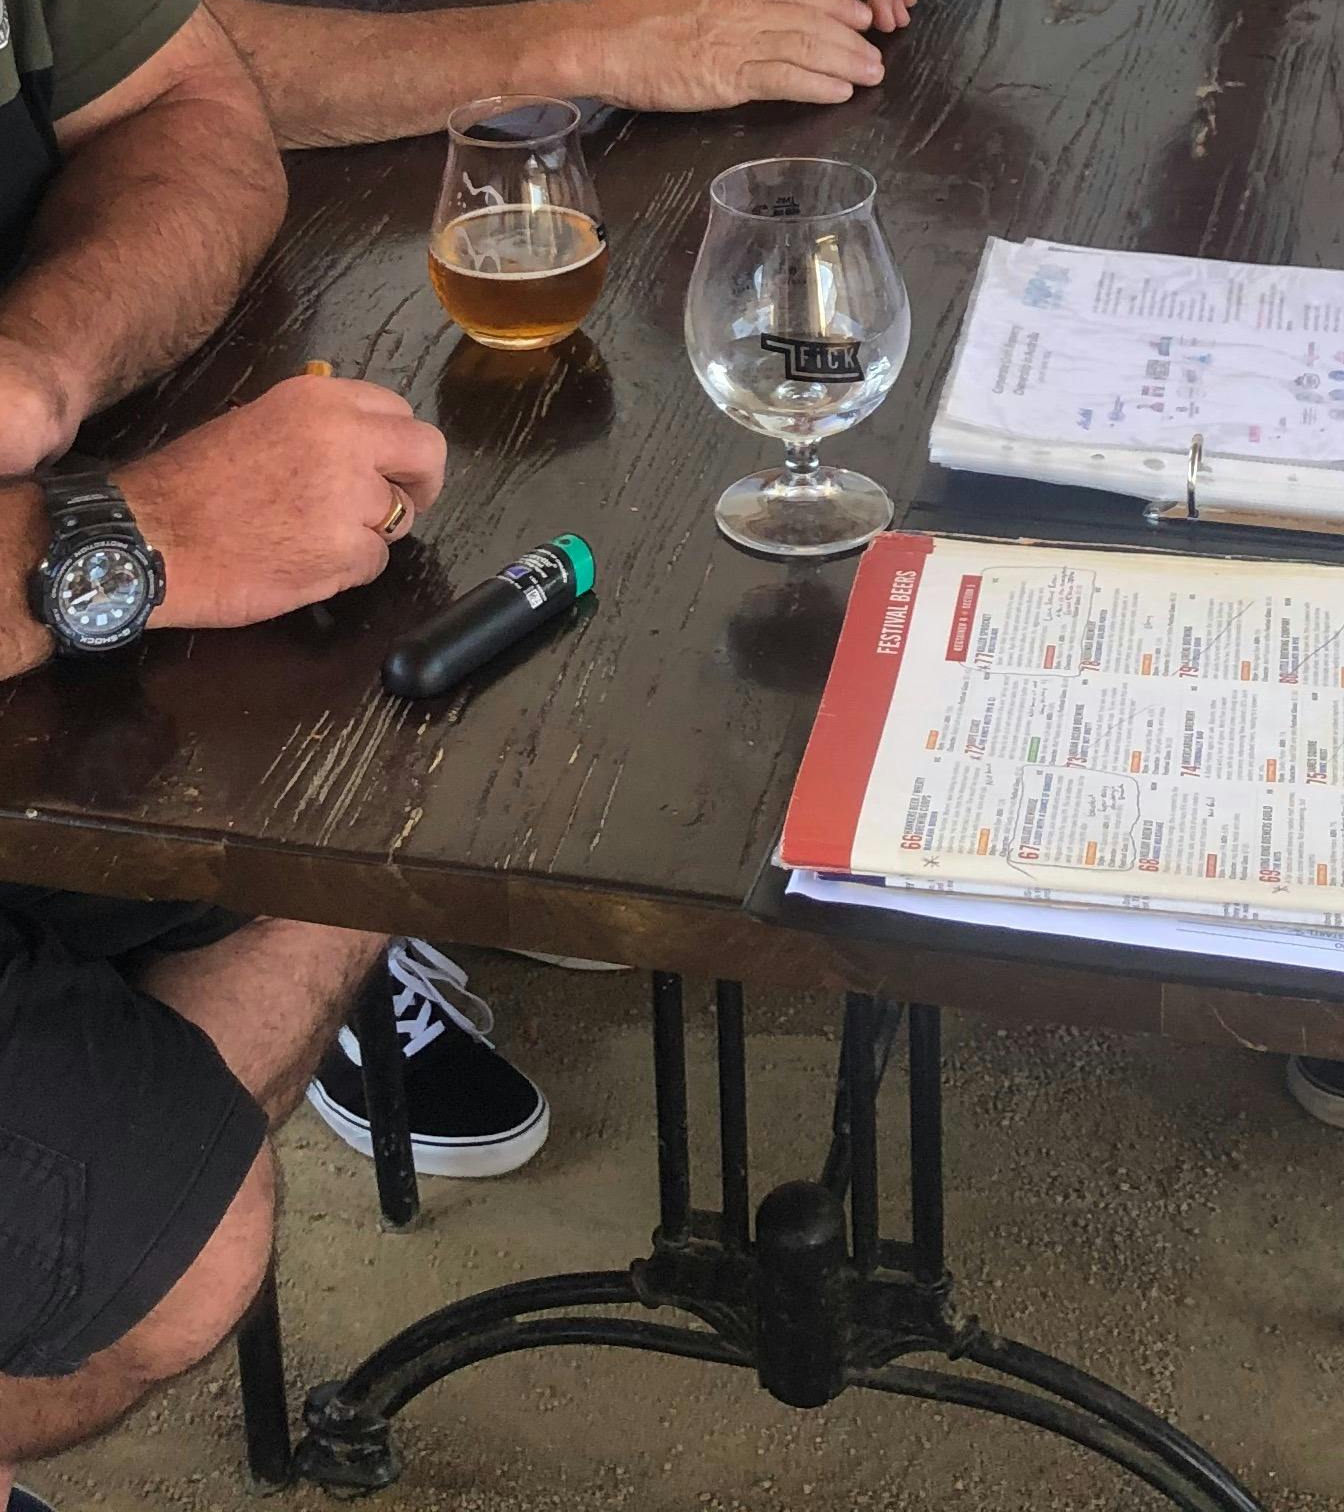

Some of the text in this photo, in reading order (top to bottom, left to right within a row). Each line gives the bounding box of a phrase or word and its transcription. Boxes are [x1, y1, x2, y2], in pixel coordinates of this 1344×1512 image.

[877, 570, 917, 654] FESTIVAL BEERS
[974, 652, 994, 664] 77
[964, 743, 985, 754] 72
[1066, 755, 1087, 768] 73
[1180, 764, 1200, 777] 74
[1306, 772, 1326, 785] 75
[900, 834, 922, 850] 66
[1017, 844, 1040, 859] 67
[1137, 857, 1160, 872] 68
[1259, 868, 1280, 883] 69
